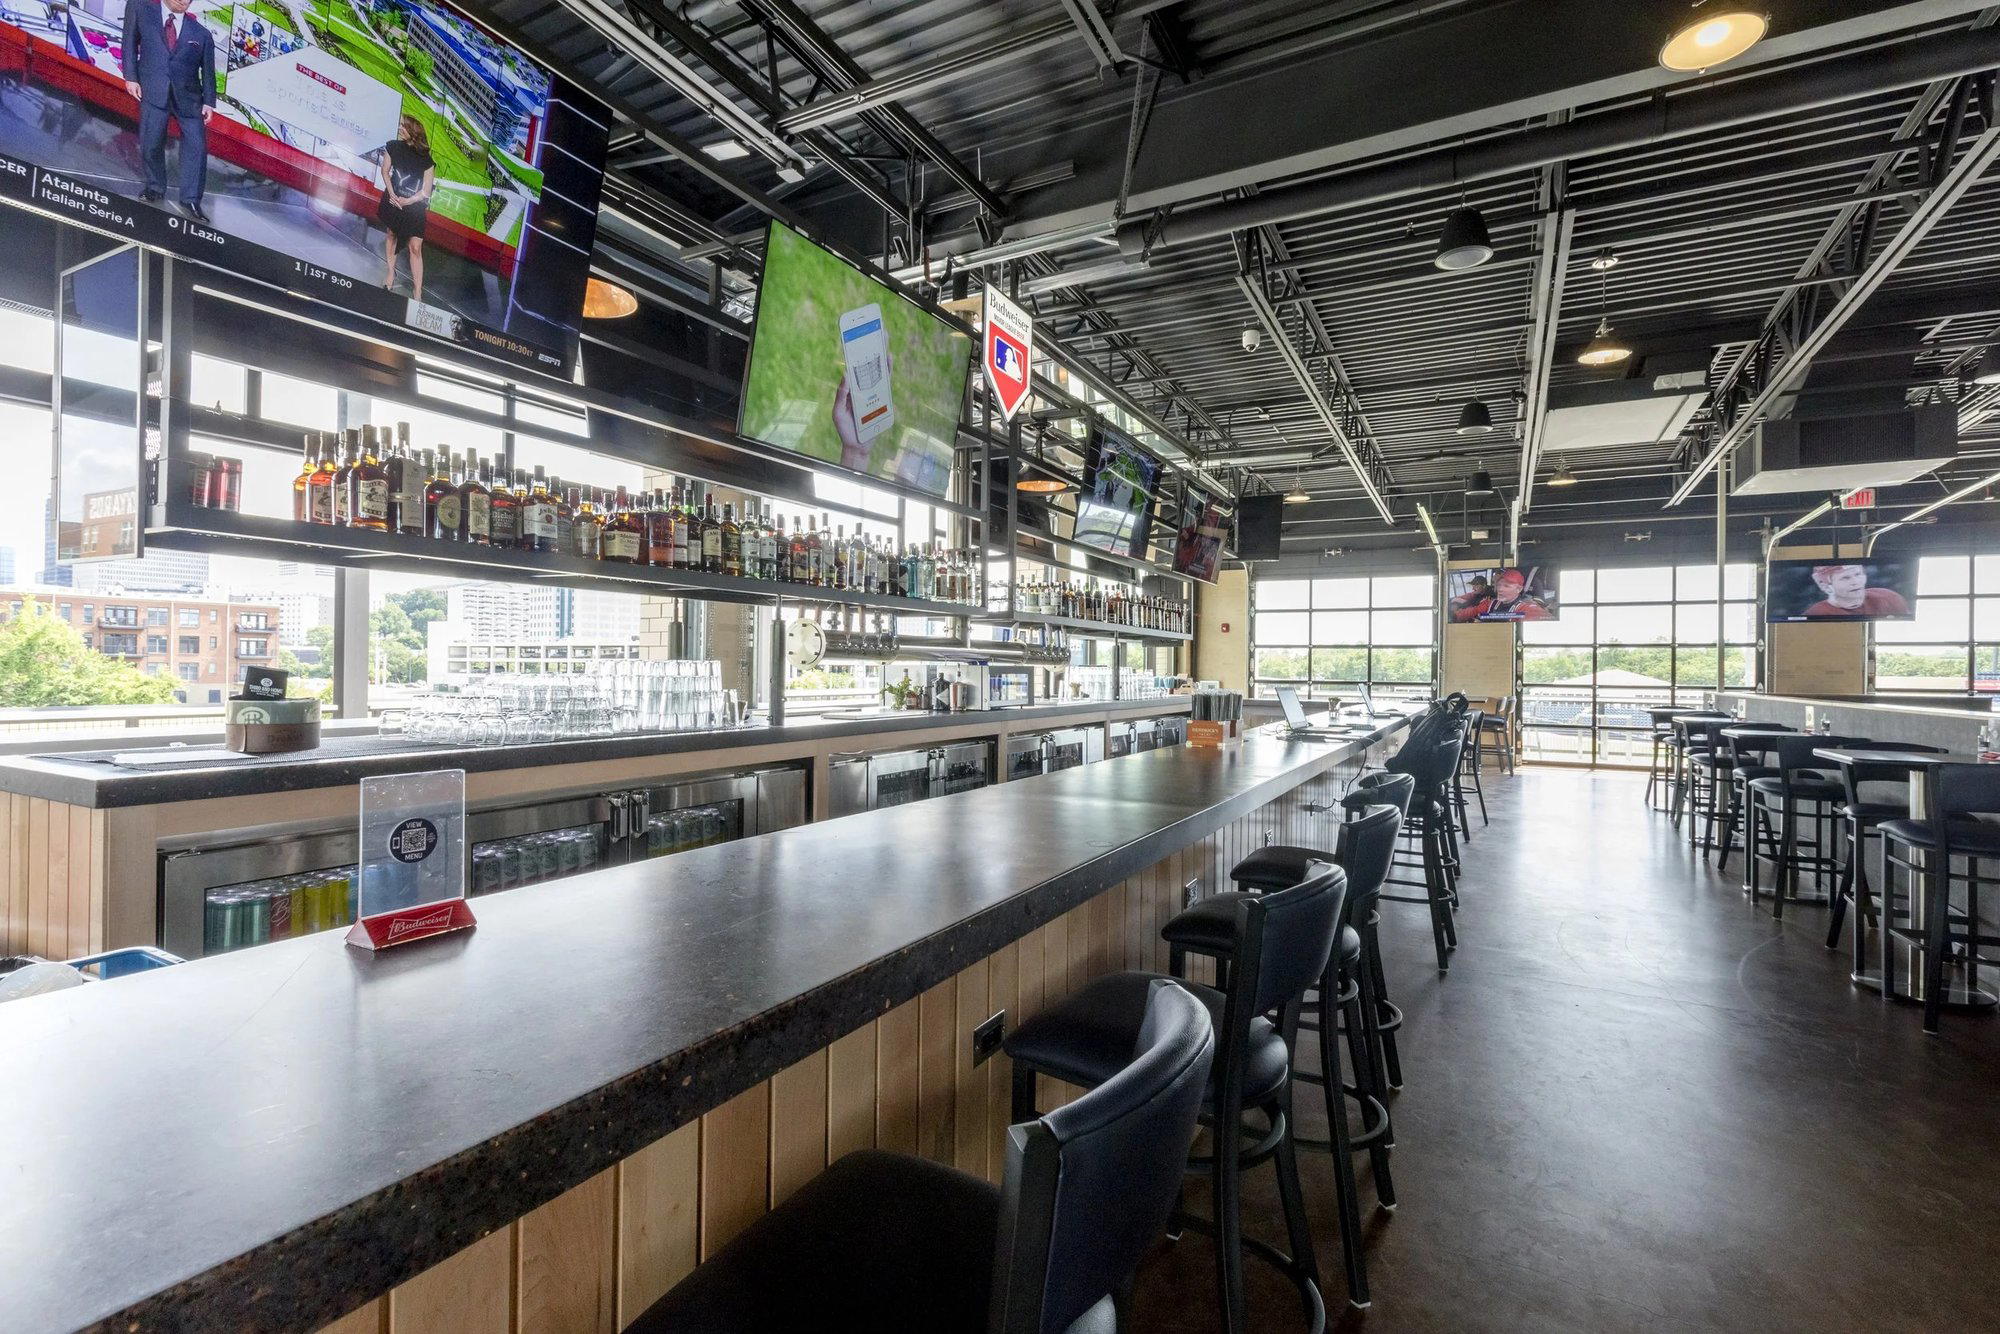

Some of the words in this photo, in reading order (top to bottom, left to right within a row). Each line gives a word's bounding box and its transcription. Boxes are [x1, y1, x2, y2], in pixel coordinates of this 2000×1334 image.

[299, 66, 314, 78] THE
[315, 73, 332, 87] BEST
[333, 82, 345, 93] OF
[41, 173, 110, 205] Atalanta
[41, 187, 85, 212] Italian
[88, 203, 123, 224] Serie
[124, 216, 135, 228] A
[190, 224, 225, 245] Lazio
[294, 261, 302, 272] 1
[309, 268, 328, 280] 1ST
[331, 275, 353, 289] 9:00
[990, 292, 1029, 333] Budweiser
[474, 329, 507, 348] TONIGHT
[538, 353, 561, 367] ESPN
[1847, 491, 1872, 506] EXIT
[405, 821, 423, 829] VIEW
[405, 852, 423, 860] MENU
[393, 914, 449, 932] Budweiser
